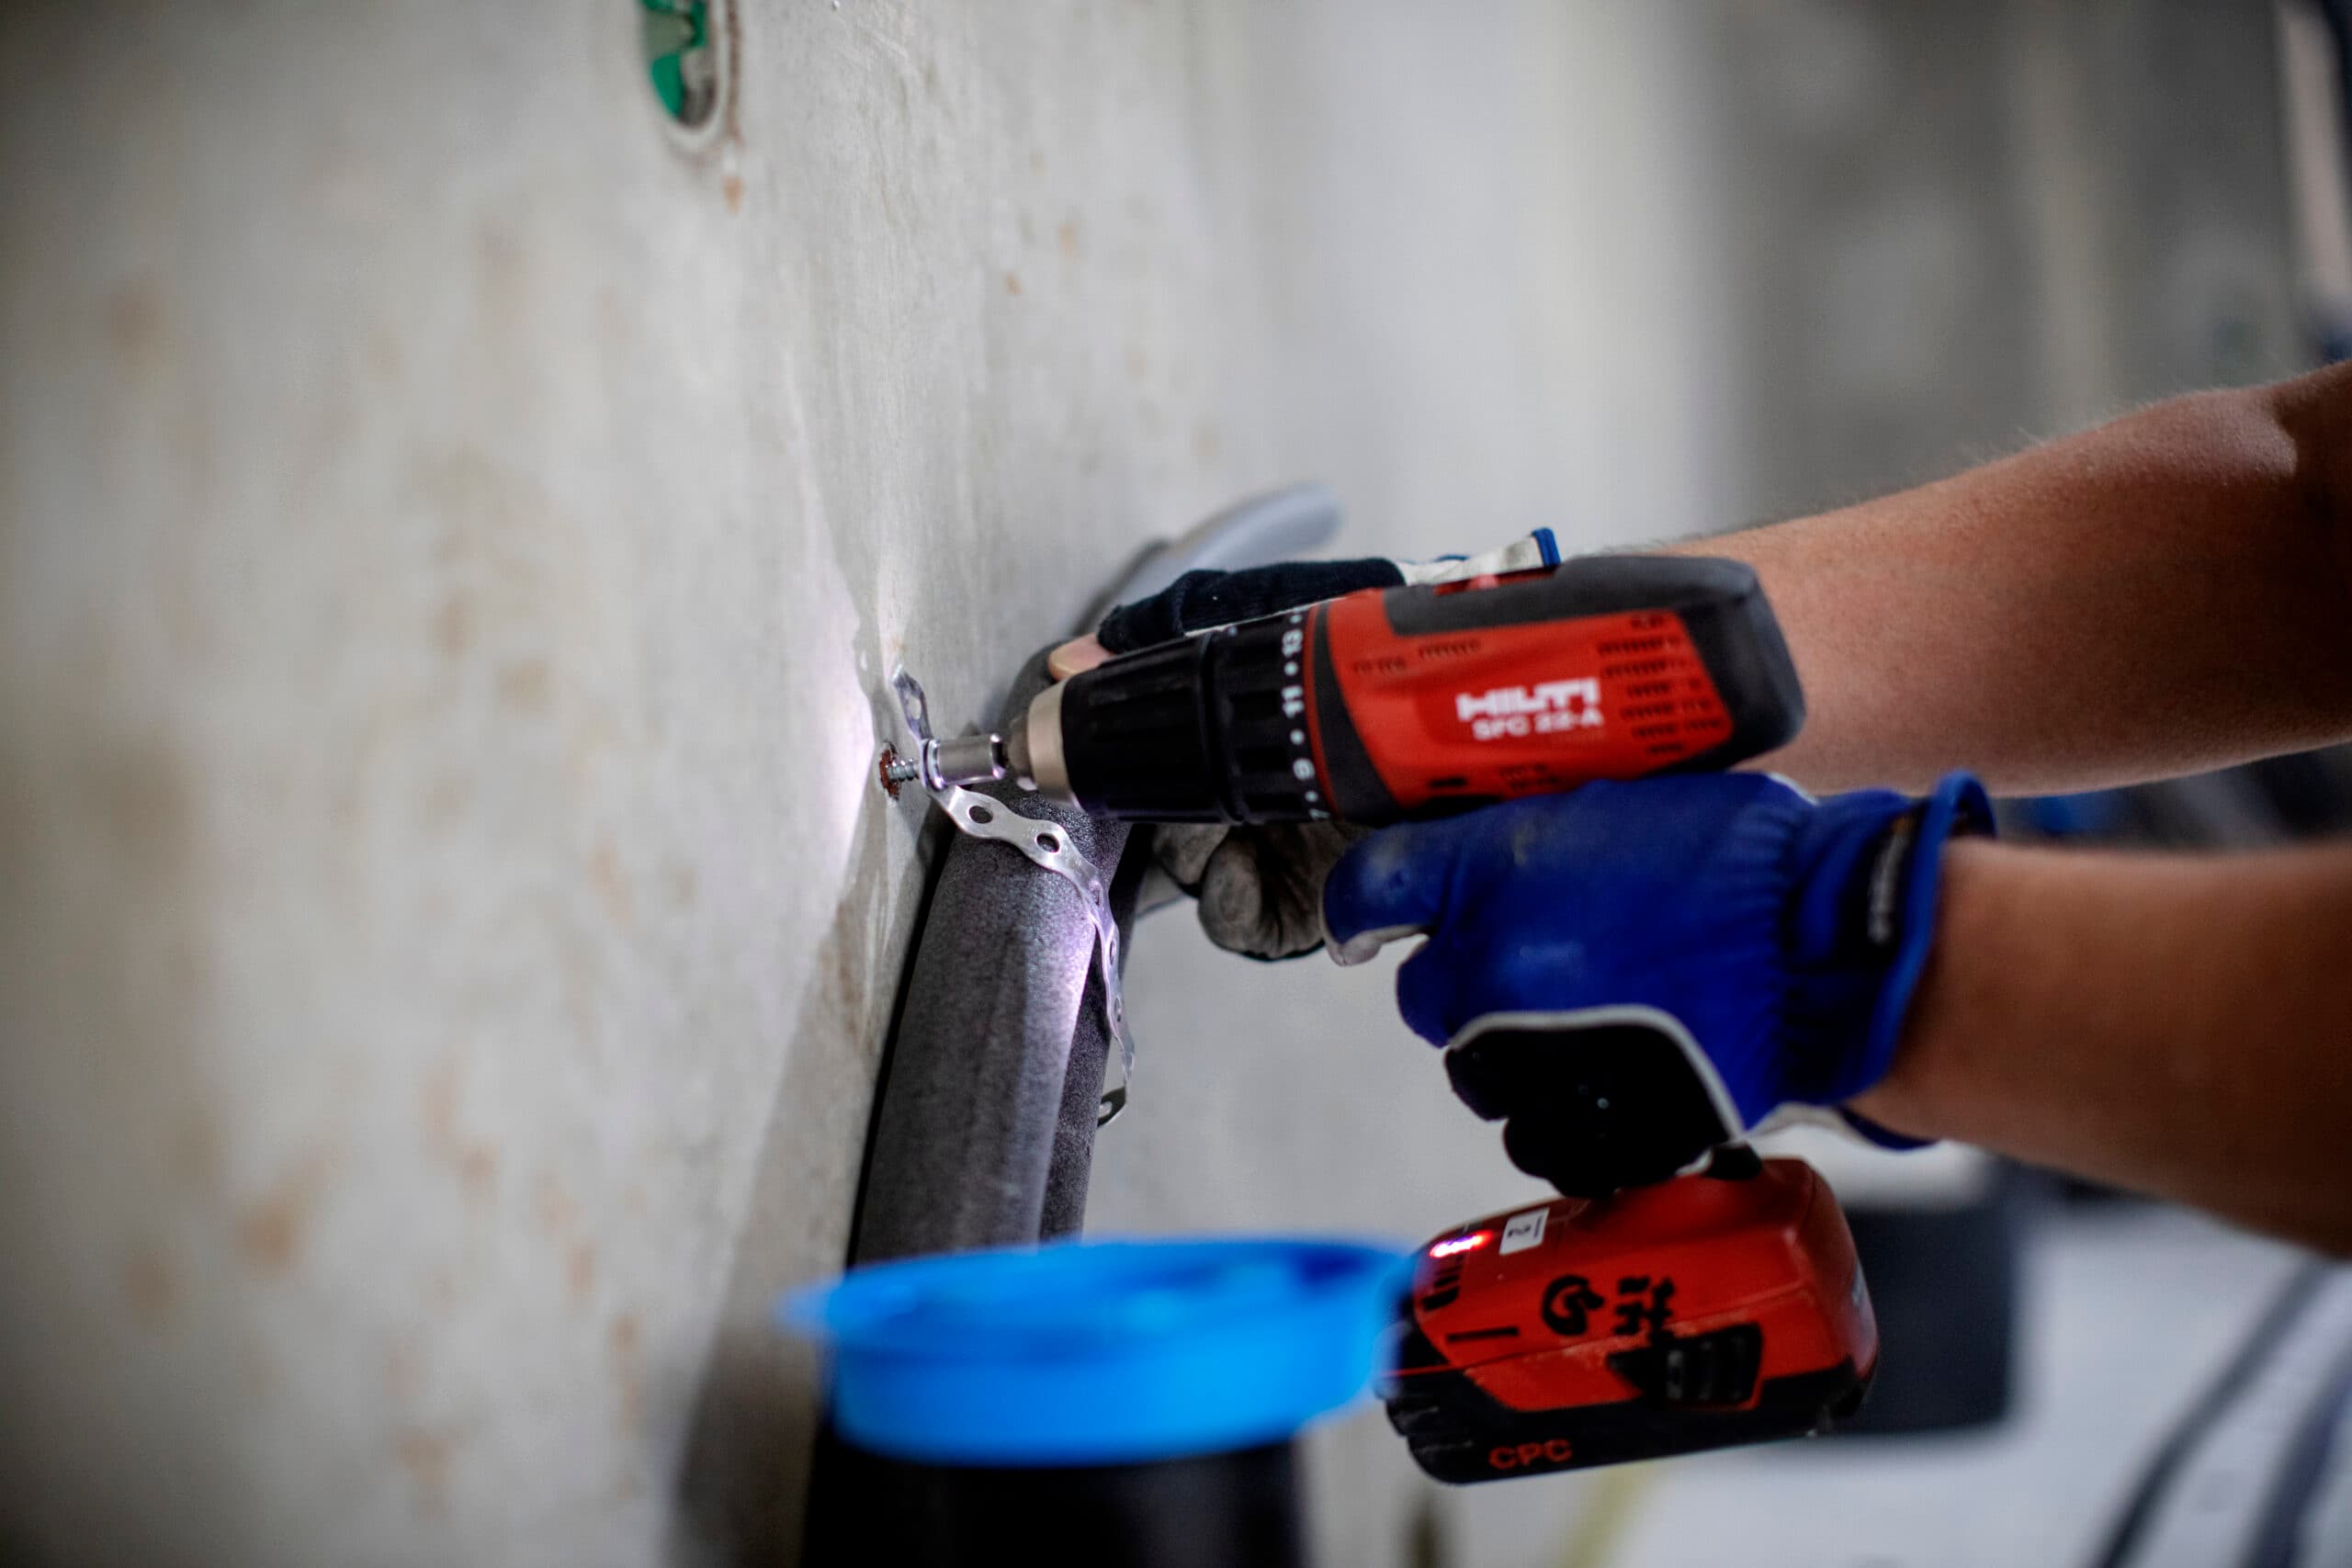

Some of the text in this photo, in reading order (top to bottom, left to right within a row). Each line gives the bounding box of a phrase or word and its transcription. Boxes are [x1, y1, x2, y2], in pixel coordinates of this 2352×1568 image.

[1282, 685, 1304, 717] 11
[1455, 676, 1600, 721] HILTI
[1472, 716, 1530, 740] SFC
[1488, 1438, 1573, 1471] CPC
